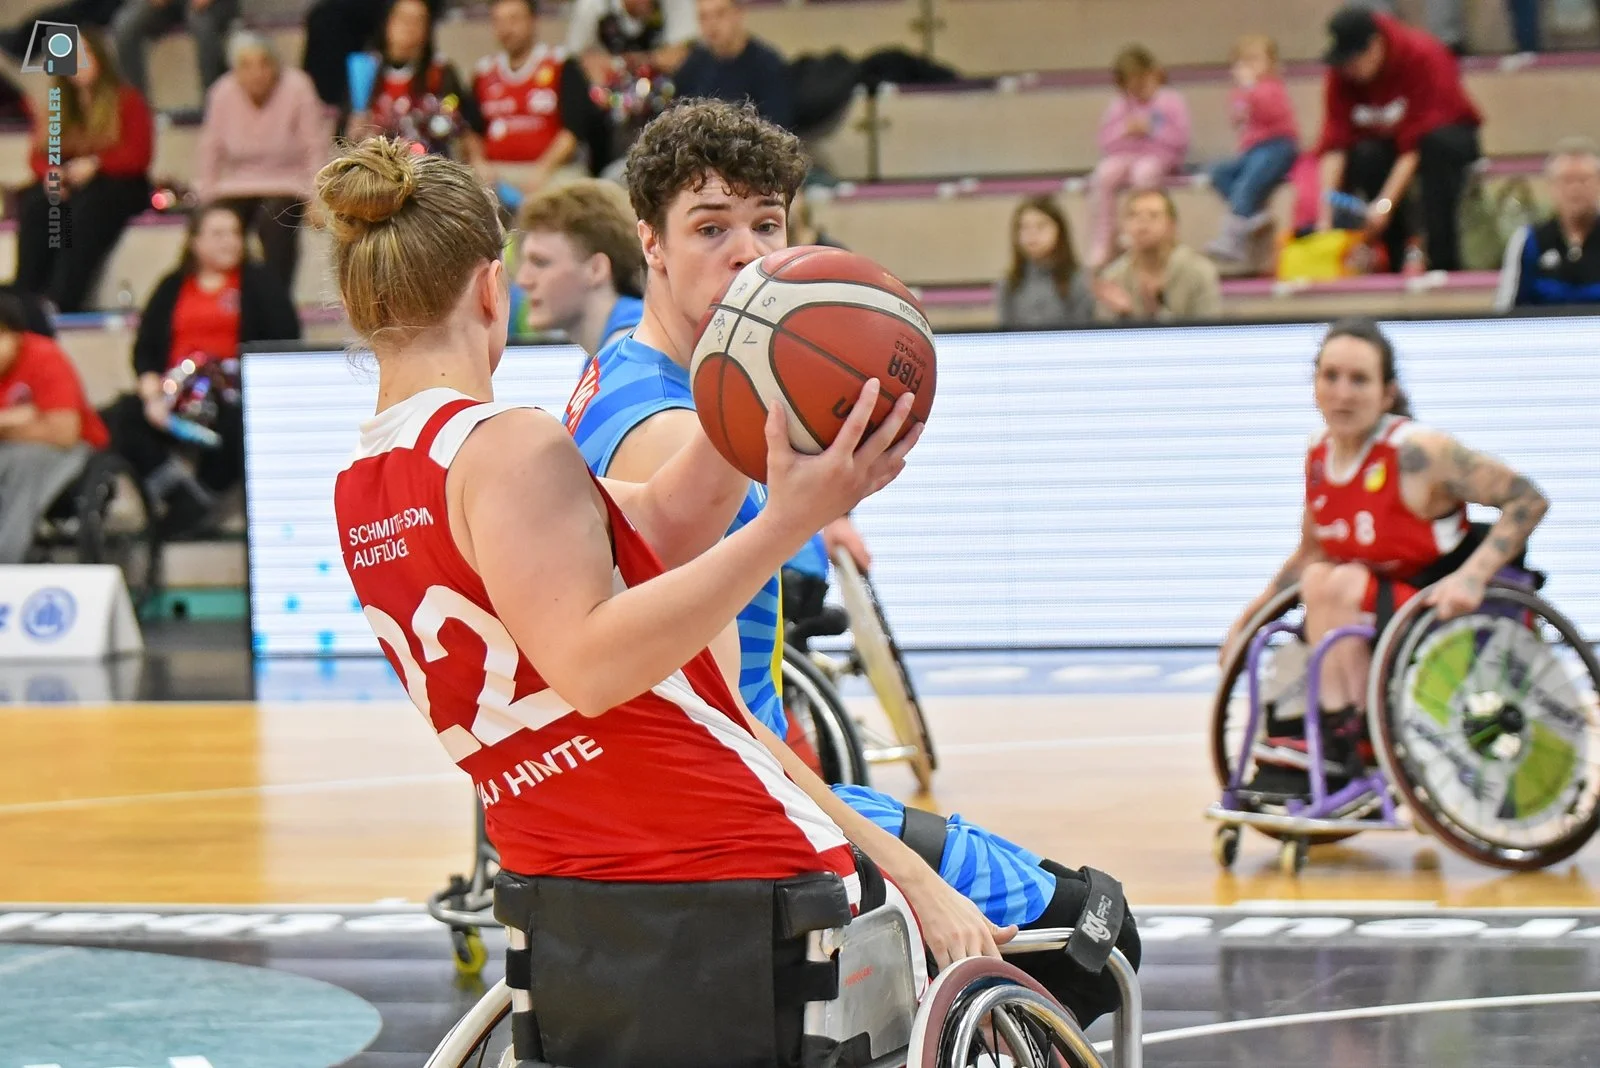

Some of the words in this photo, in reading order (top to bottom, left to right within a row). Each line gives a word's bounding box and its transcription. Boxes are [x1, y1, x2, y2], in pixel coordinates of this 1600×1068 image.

[887, 354, 925, 395] FIBA
[1354, 510, 1376, 546] 8
[502, 735, 604, 797] HINTE
